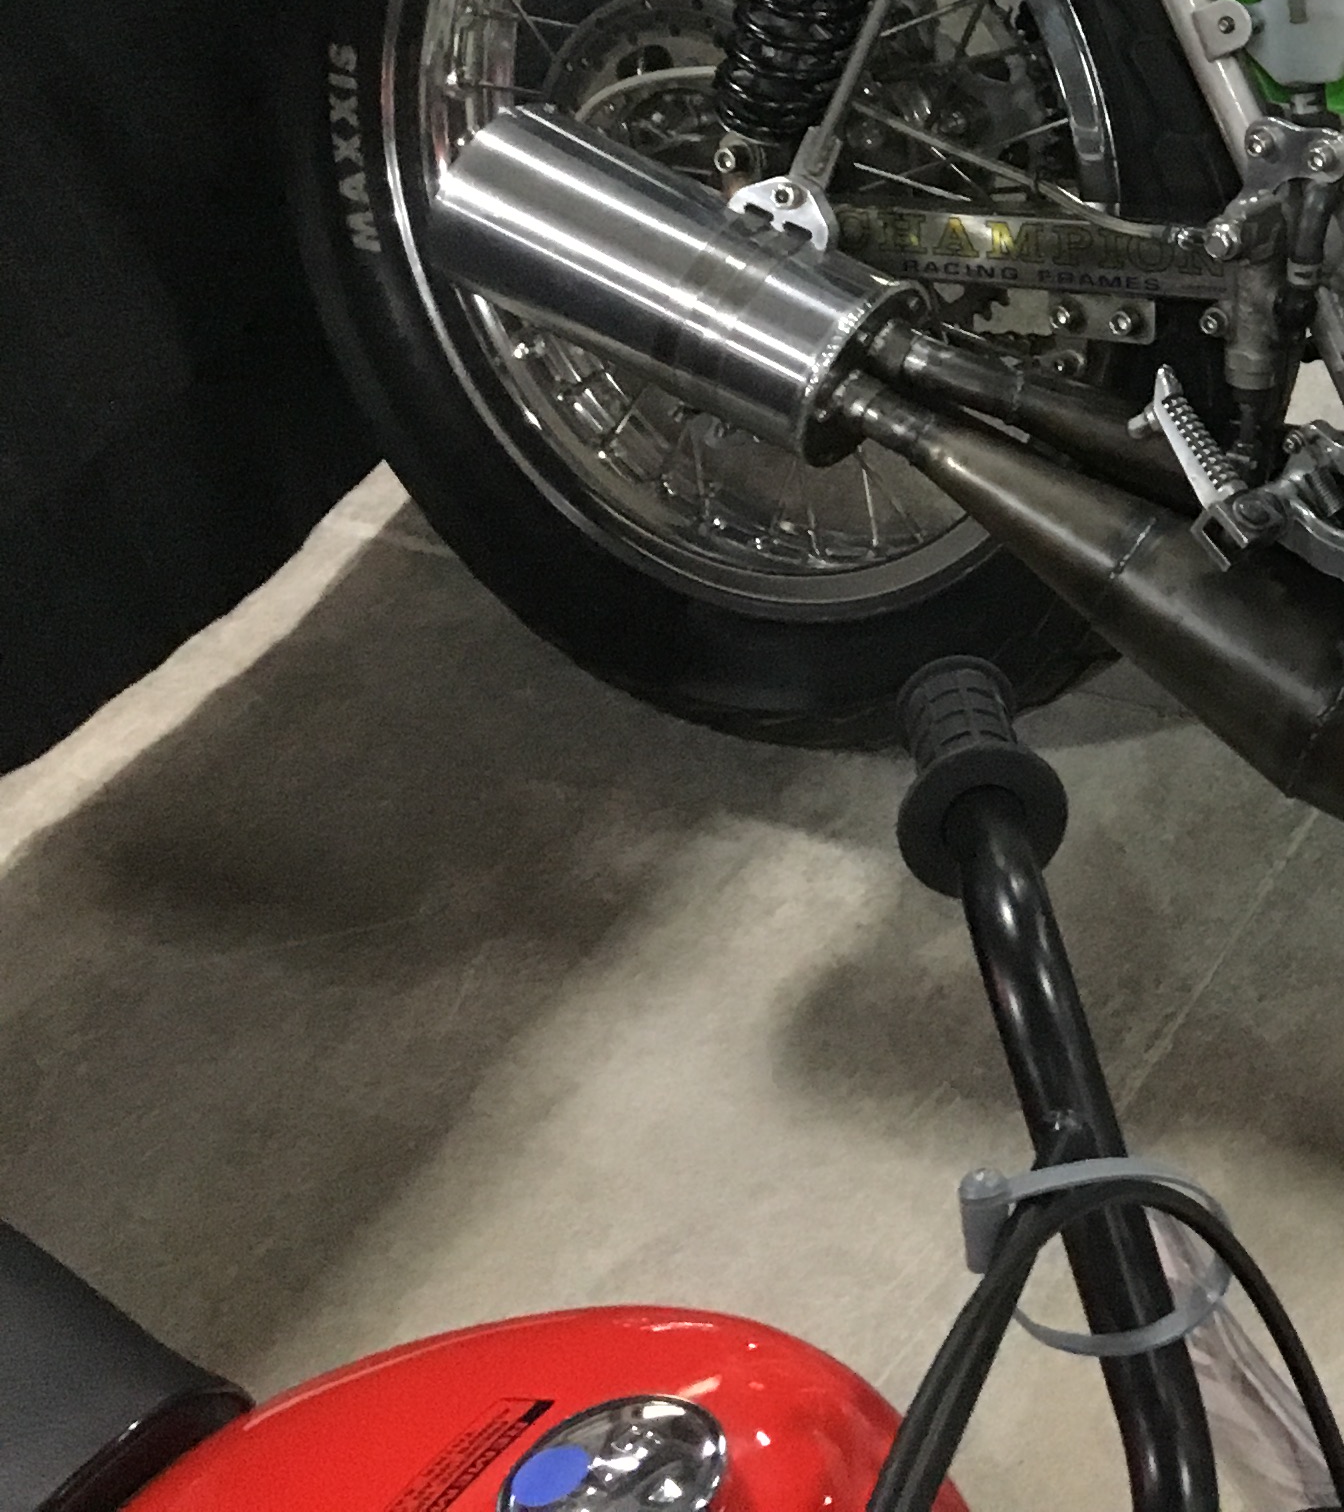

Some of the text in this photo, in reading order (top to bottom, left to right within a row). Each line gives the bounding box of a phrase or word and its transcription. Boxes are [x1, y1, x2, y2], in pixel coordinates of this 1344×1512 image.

[328, 41, 382, 253] MAXXIS
[834, 203, 1225, 277] CHAMPION
[904, 259, 1019, 282] RACING
[1038, 268, 1161, 291] FRAMES
